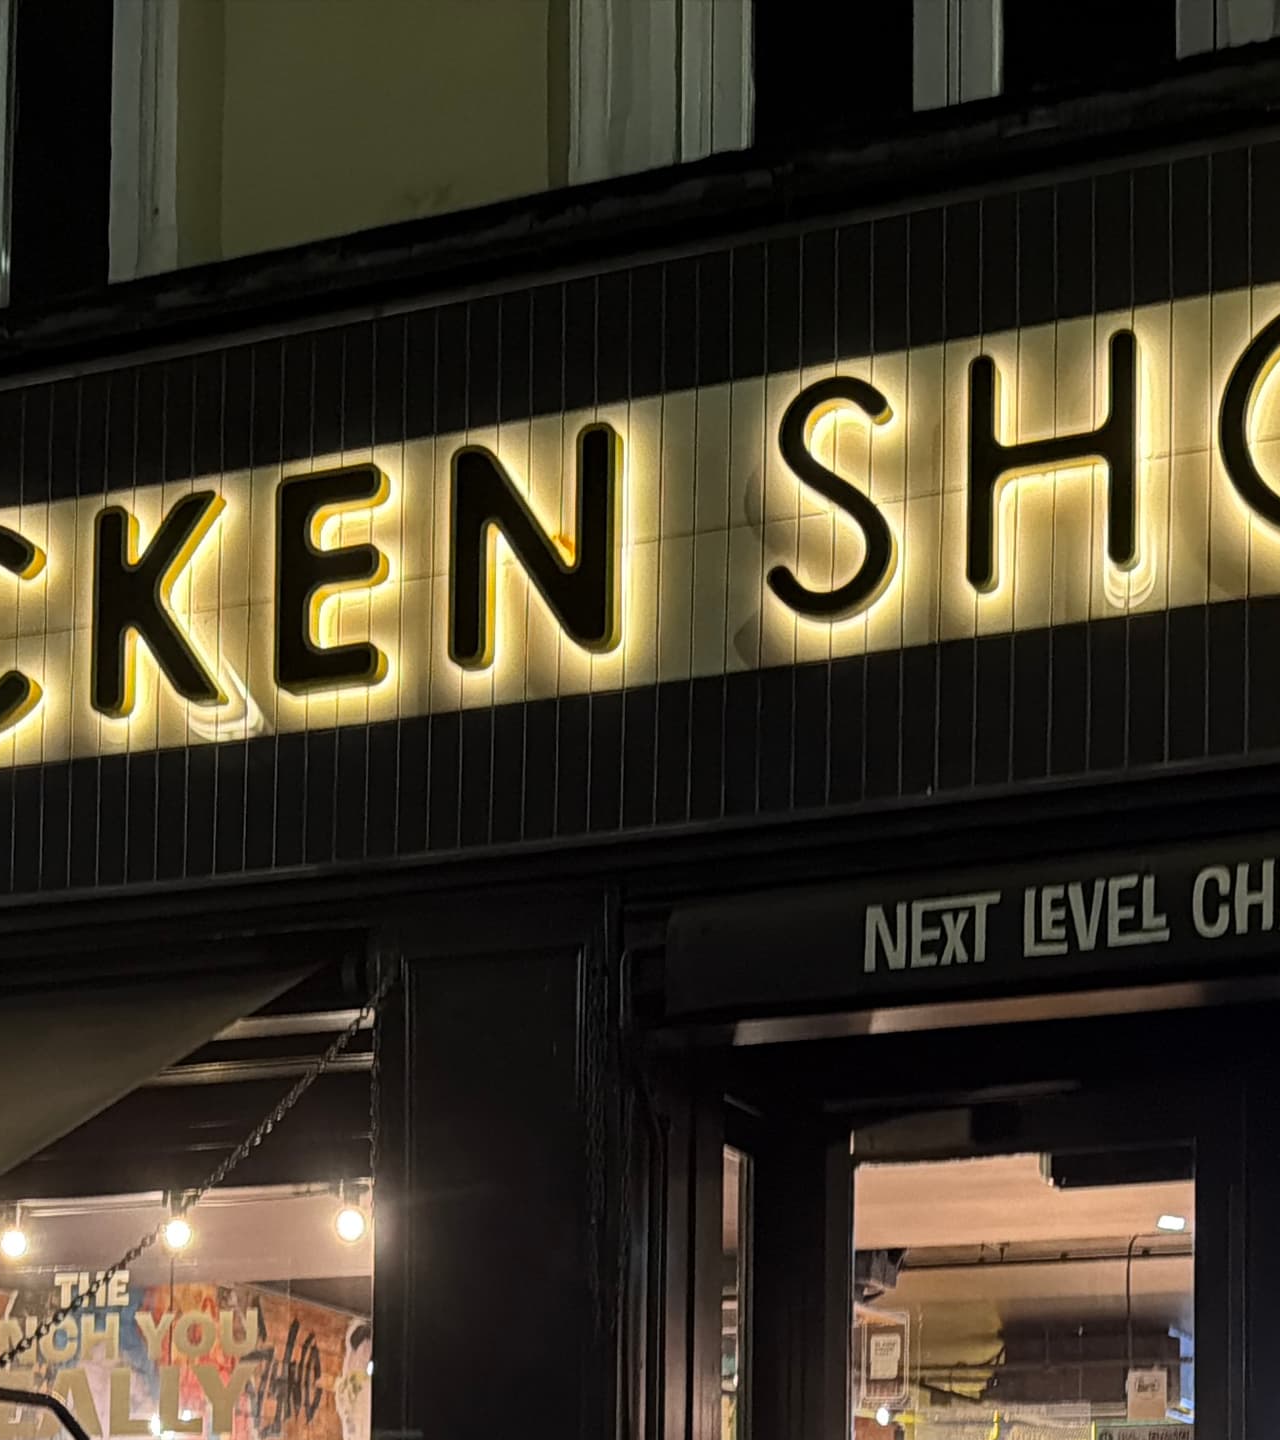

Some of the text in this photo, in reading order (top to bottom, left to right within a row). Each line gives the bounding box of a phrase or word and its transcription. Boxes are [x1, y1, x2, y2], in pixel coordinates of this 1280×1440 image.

[863, 891, 1001, 973] NEXT
[1023, 873, 1170, 958] LEVEL
[54, 1269, 130, 1308] THE
[135, 1307, 259, 1360] YOU
